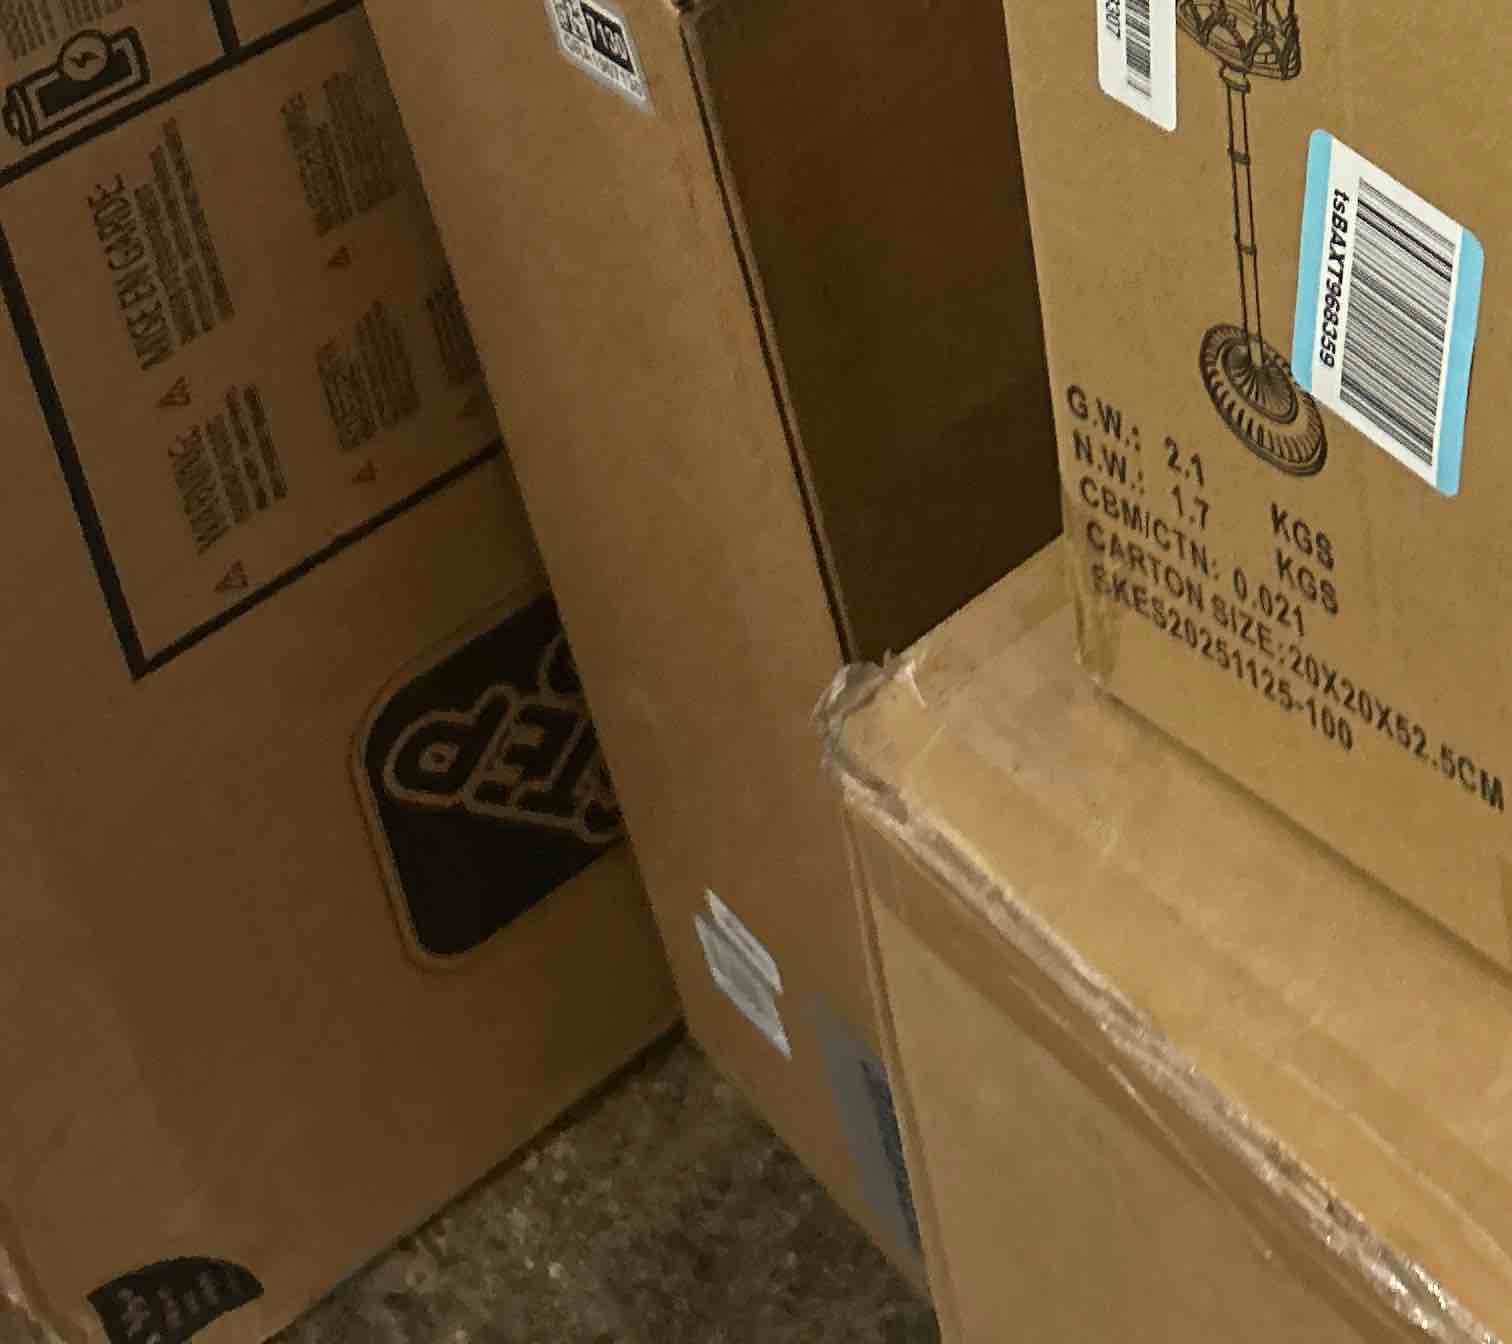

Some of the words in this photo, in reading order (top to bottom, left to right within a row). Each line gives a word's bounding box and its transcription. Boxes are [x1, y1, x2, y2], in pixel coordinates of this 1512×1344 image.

[1319, 188, 1350, 368] tsBAXT968359
[1066, 384, 1142, 454] G.W.:
[1165, 436, 1207, 487] 2.1
[1271, 502, 1336, 574] KGS
[1074, 430, 1145, 497] N.W.:
[1170, 484, 1211, 530] 1.7
[1276, 546, 1339, 617] KGS
[1079, 478, 1220, 580] CBM/CTN:
[1232, 570, 1307, 638] 0.021
[1085, 520, 1206, 614] CARTON
